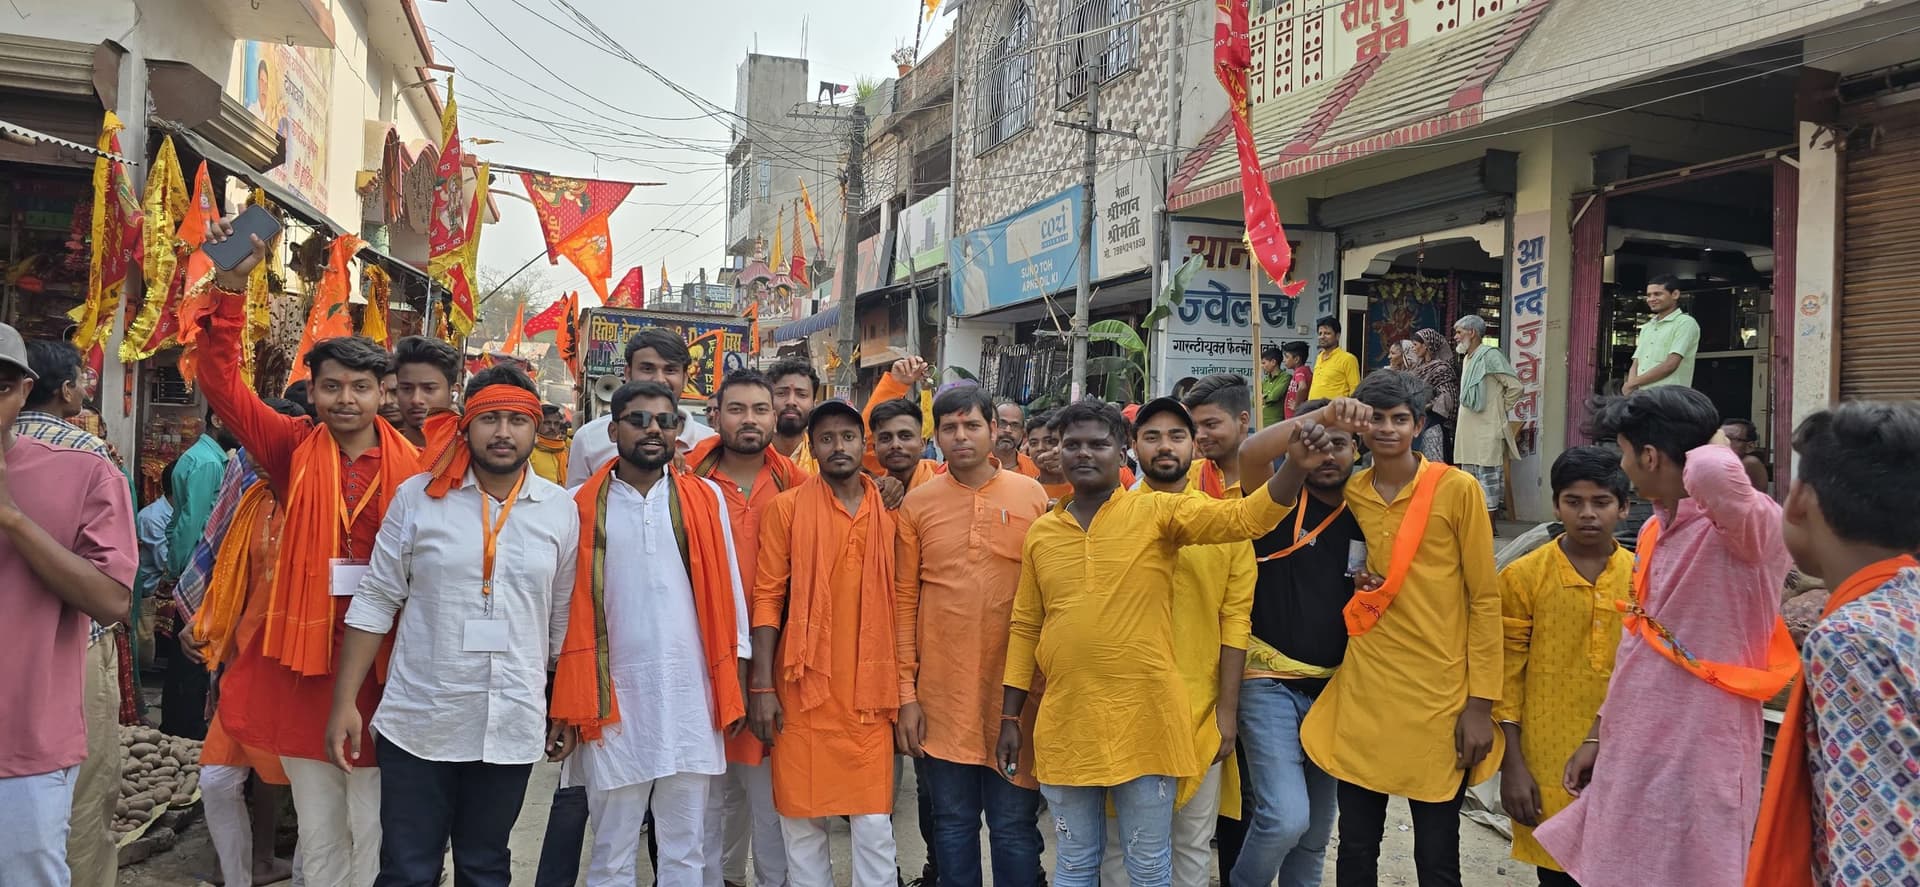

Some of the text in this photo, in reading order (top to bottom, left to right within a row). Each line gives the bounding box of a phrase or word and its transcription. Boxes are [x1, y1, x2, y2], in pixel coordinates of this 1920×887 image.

[1107, 196, 1140, 222] श्रीमान
[1108, 216, 1141, 244] श्रीमती
[1022, 259, 1053, 279] SUNO TOH
[1052, 272, 1059, 284] KI
[592, 315, 619, 342] रितेश
